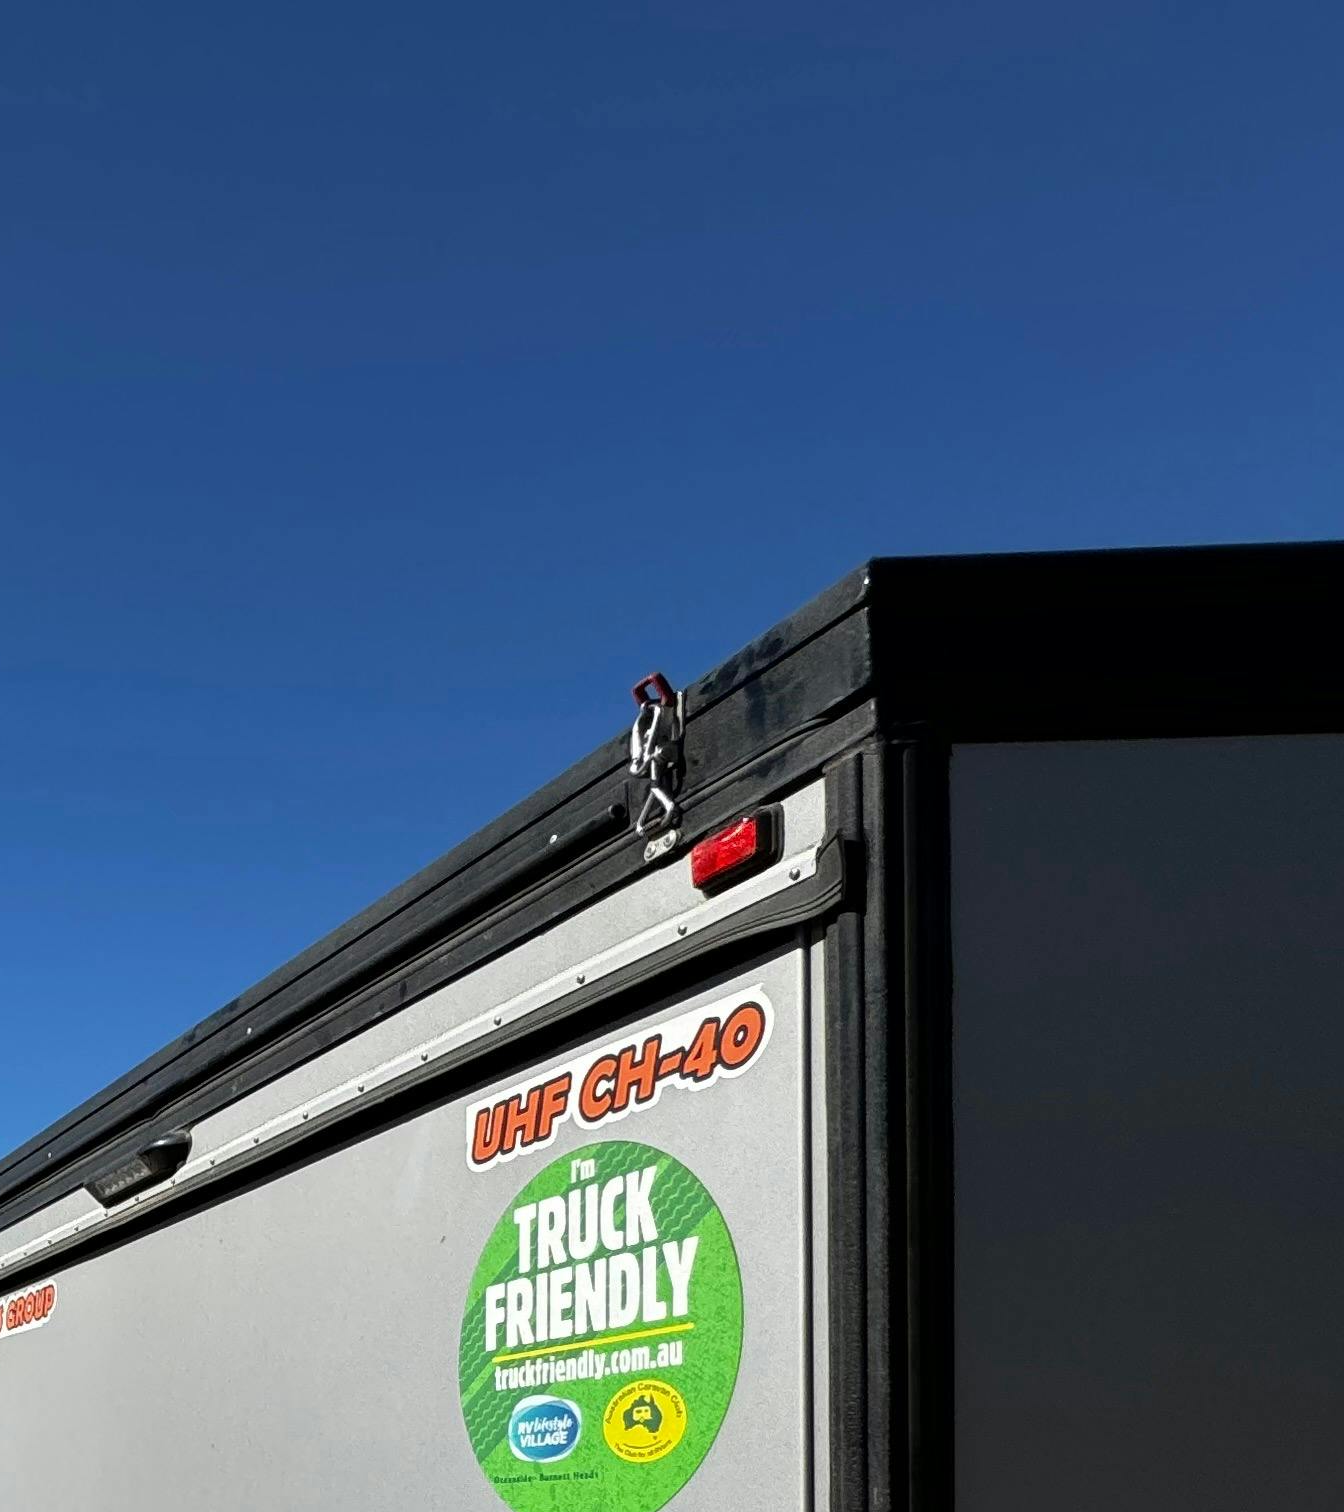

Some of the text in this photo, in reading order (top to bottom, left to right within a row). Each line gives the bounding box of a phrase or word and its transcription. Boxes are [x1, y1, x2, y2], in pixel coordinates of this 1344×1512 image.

[471, 1001, 766, 1165] UHF CH-40
[571, 1159, 595, 1183] I'm
[514, 1165, 658, 1274] TRUCK
[6, 1284, 55, 1330] GROUP
[485, 1235, 700, 1351] FRIENDLY
[495, 1340, 683, 1391] truckfriendly.com.au
[518, 1421, 534, 1435] RV
[520, 1431, 569, 1448] VILLAGE
